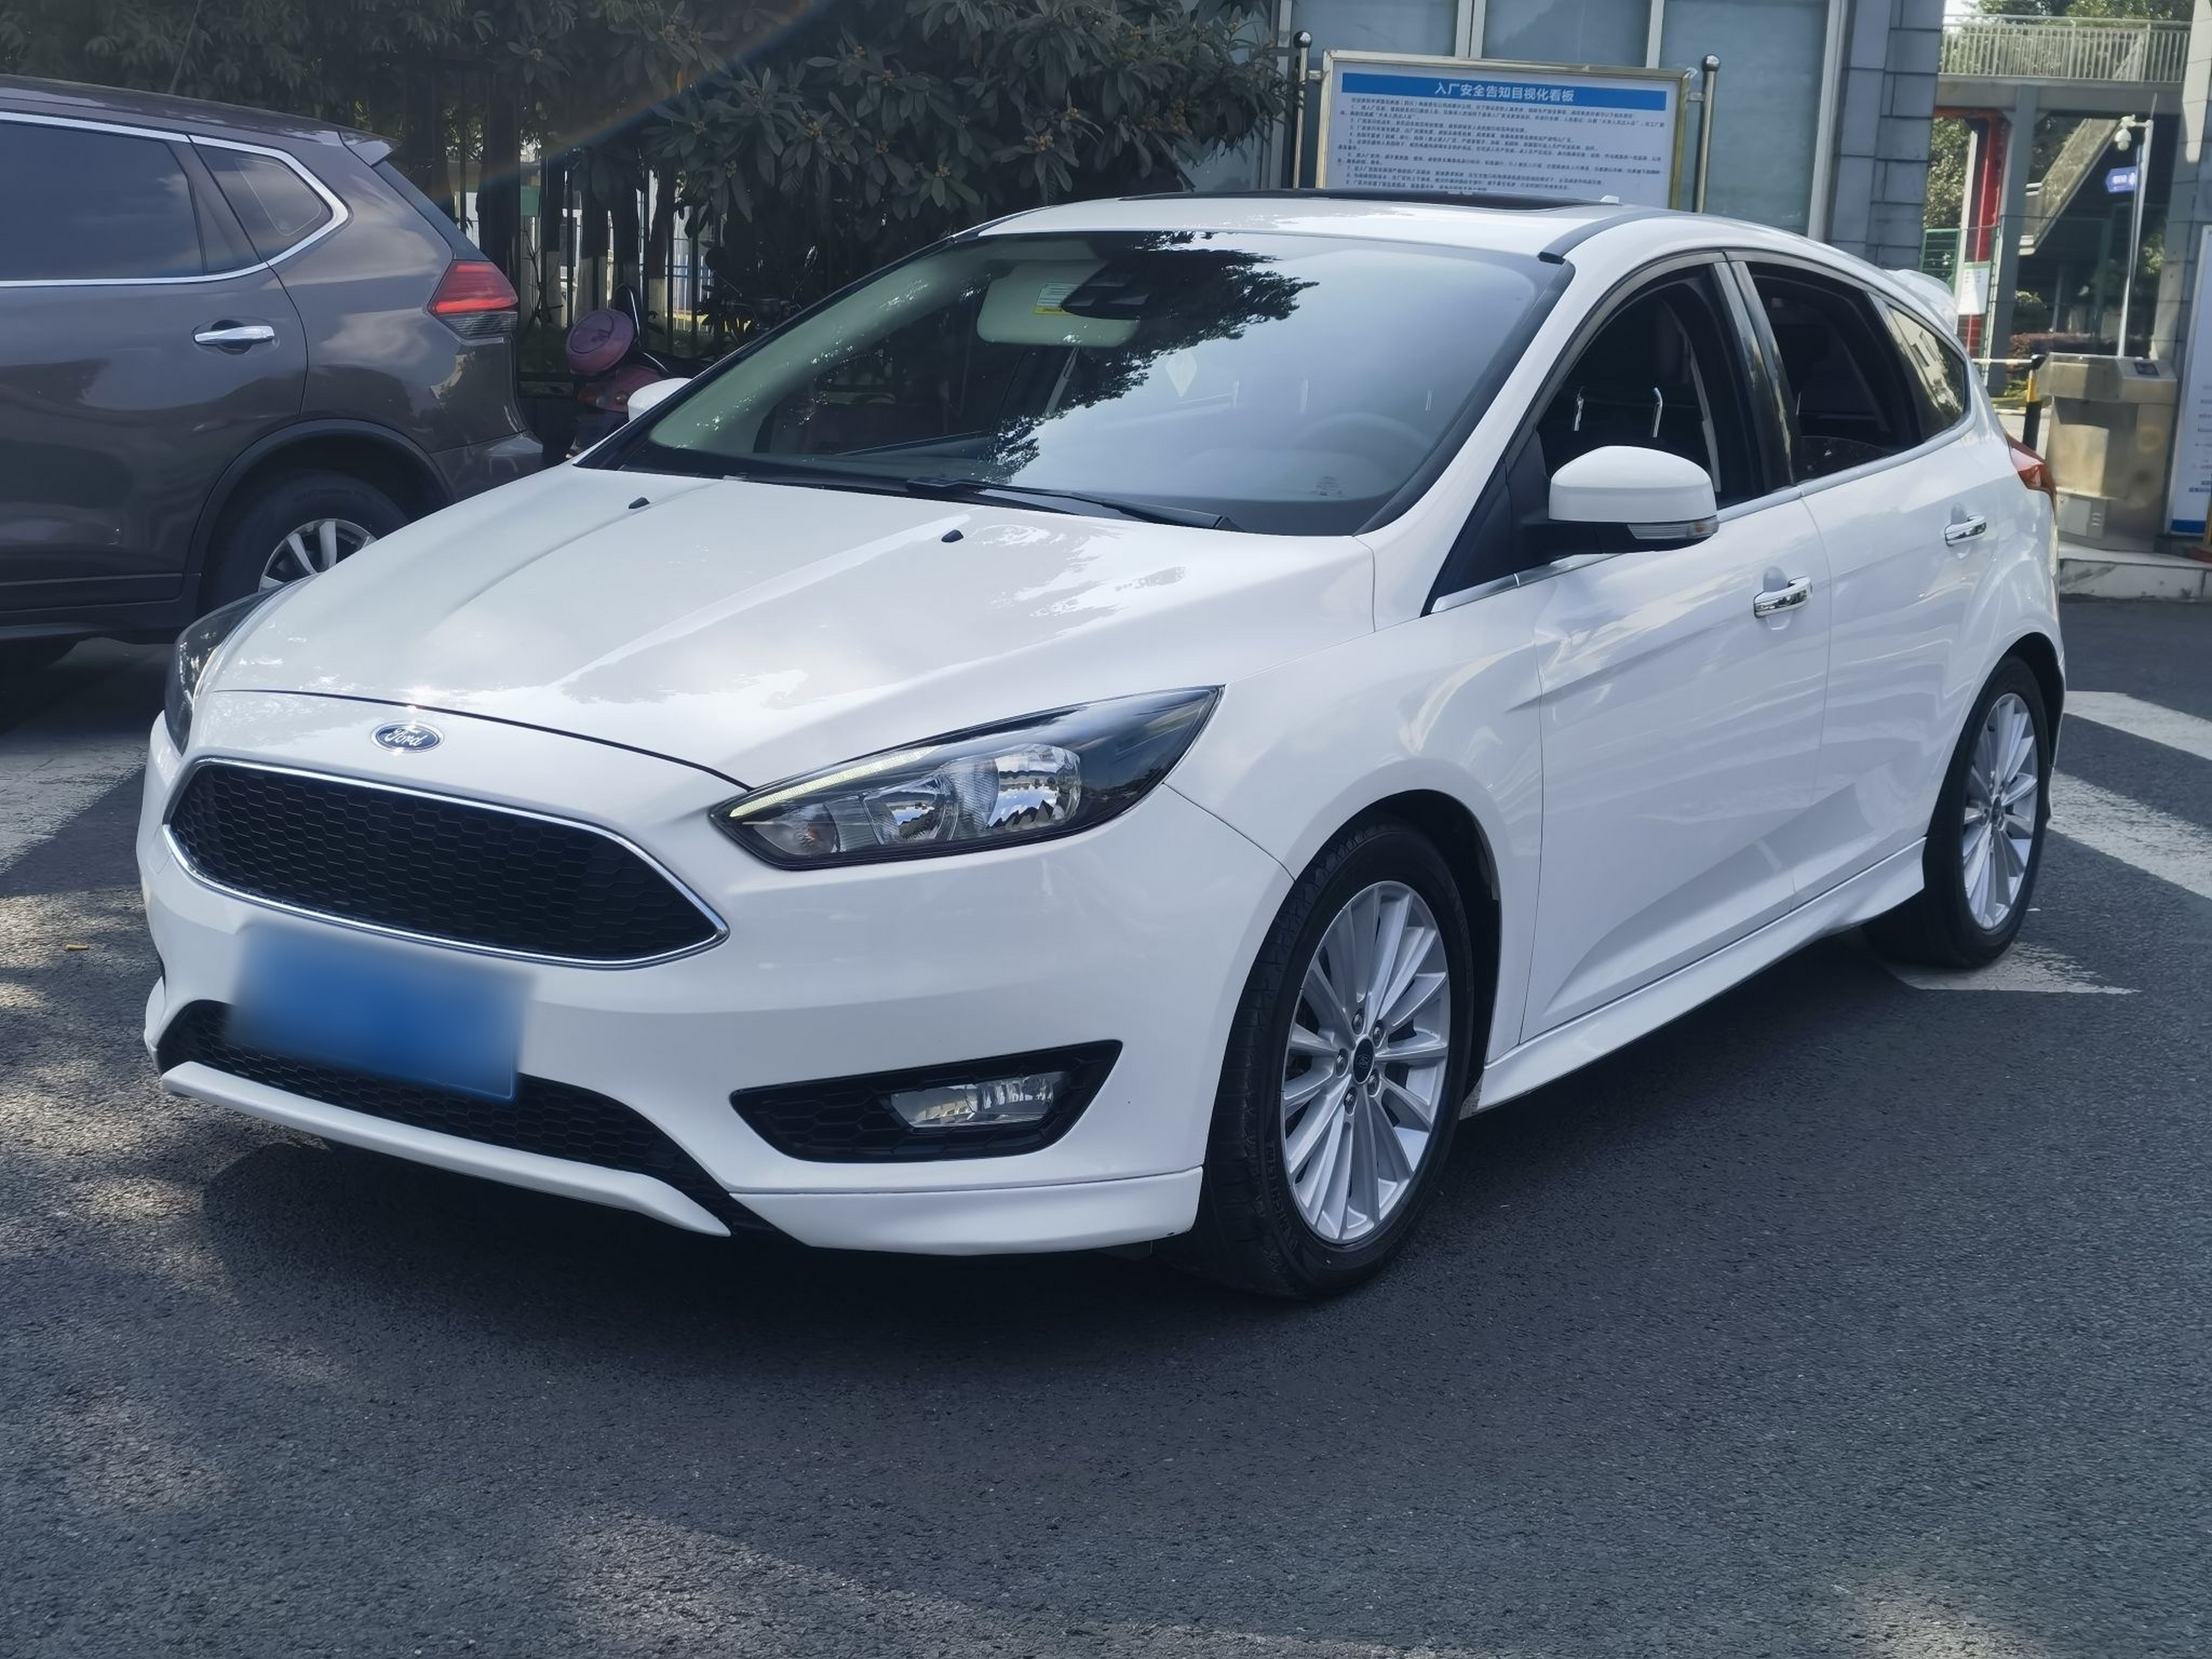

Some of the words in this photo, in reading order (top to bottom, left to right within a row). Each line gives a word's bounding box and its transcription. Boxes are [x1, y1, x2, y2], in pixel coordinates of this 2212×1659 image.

[1435, 82, 1574, 102] 入厂安全告知目视化看板
[385, 728, 428, 747] Ford
